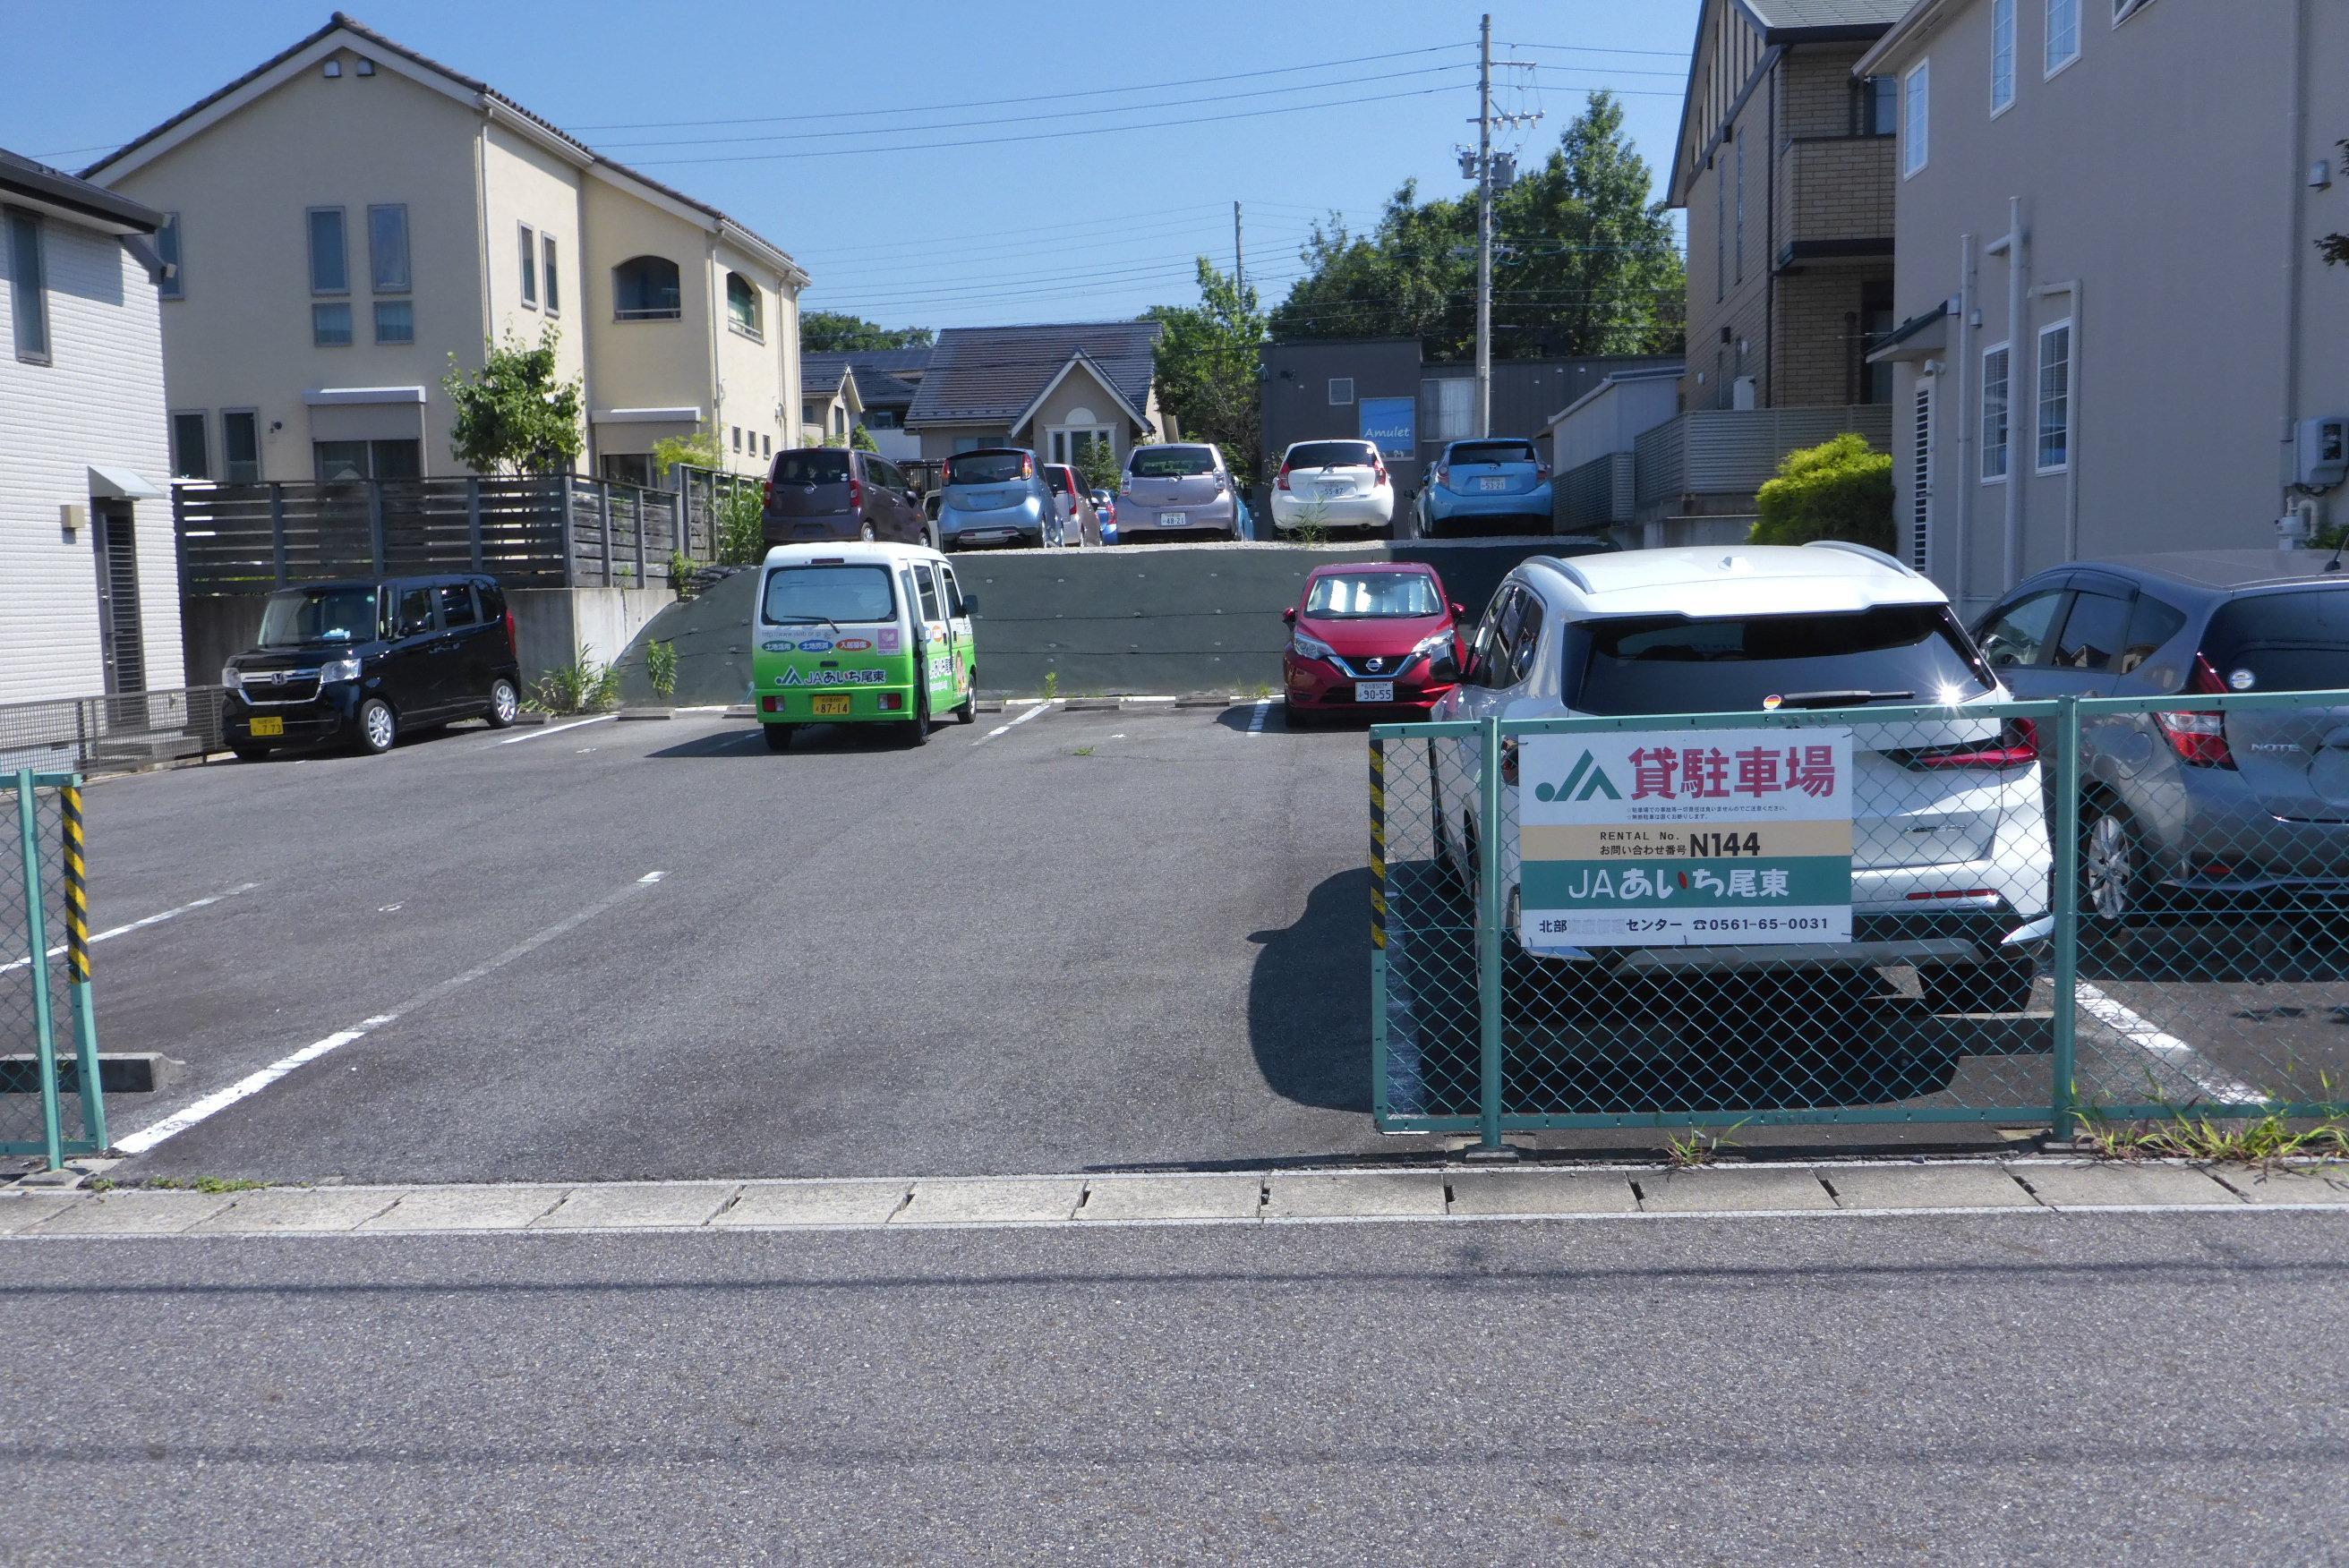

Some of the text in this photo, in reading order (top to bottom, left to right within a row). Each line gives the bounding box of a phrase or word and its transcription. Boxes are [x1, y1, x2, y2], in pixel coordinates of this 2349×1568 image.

[1364, 426, 1411, 438] Amulet
[806, 669, 885, 684] JAあいち尾東
[1364, 689, 1391, 700] 90-55
[821, 703, 848, 713] 87-14
[2251, 743, 2302, 753] NOTE
[1627, 745, 1835, 801] 貸駐車場
[1600, 831, 1680, 840] RENTAL No.
[1600, 844, 1687, 856] お問い合わせ番号
[1690, 831, 1761, 857] N144
[1568, 868, 1790, 899] JAあいち尾東
[1709, 917, 1828, 931] 0561-65-0031
